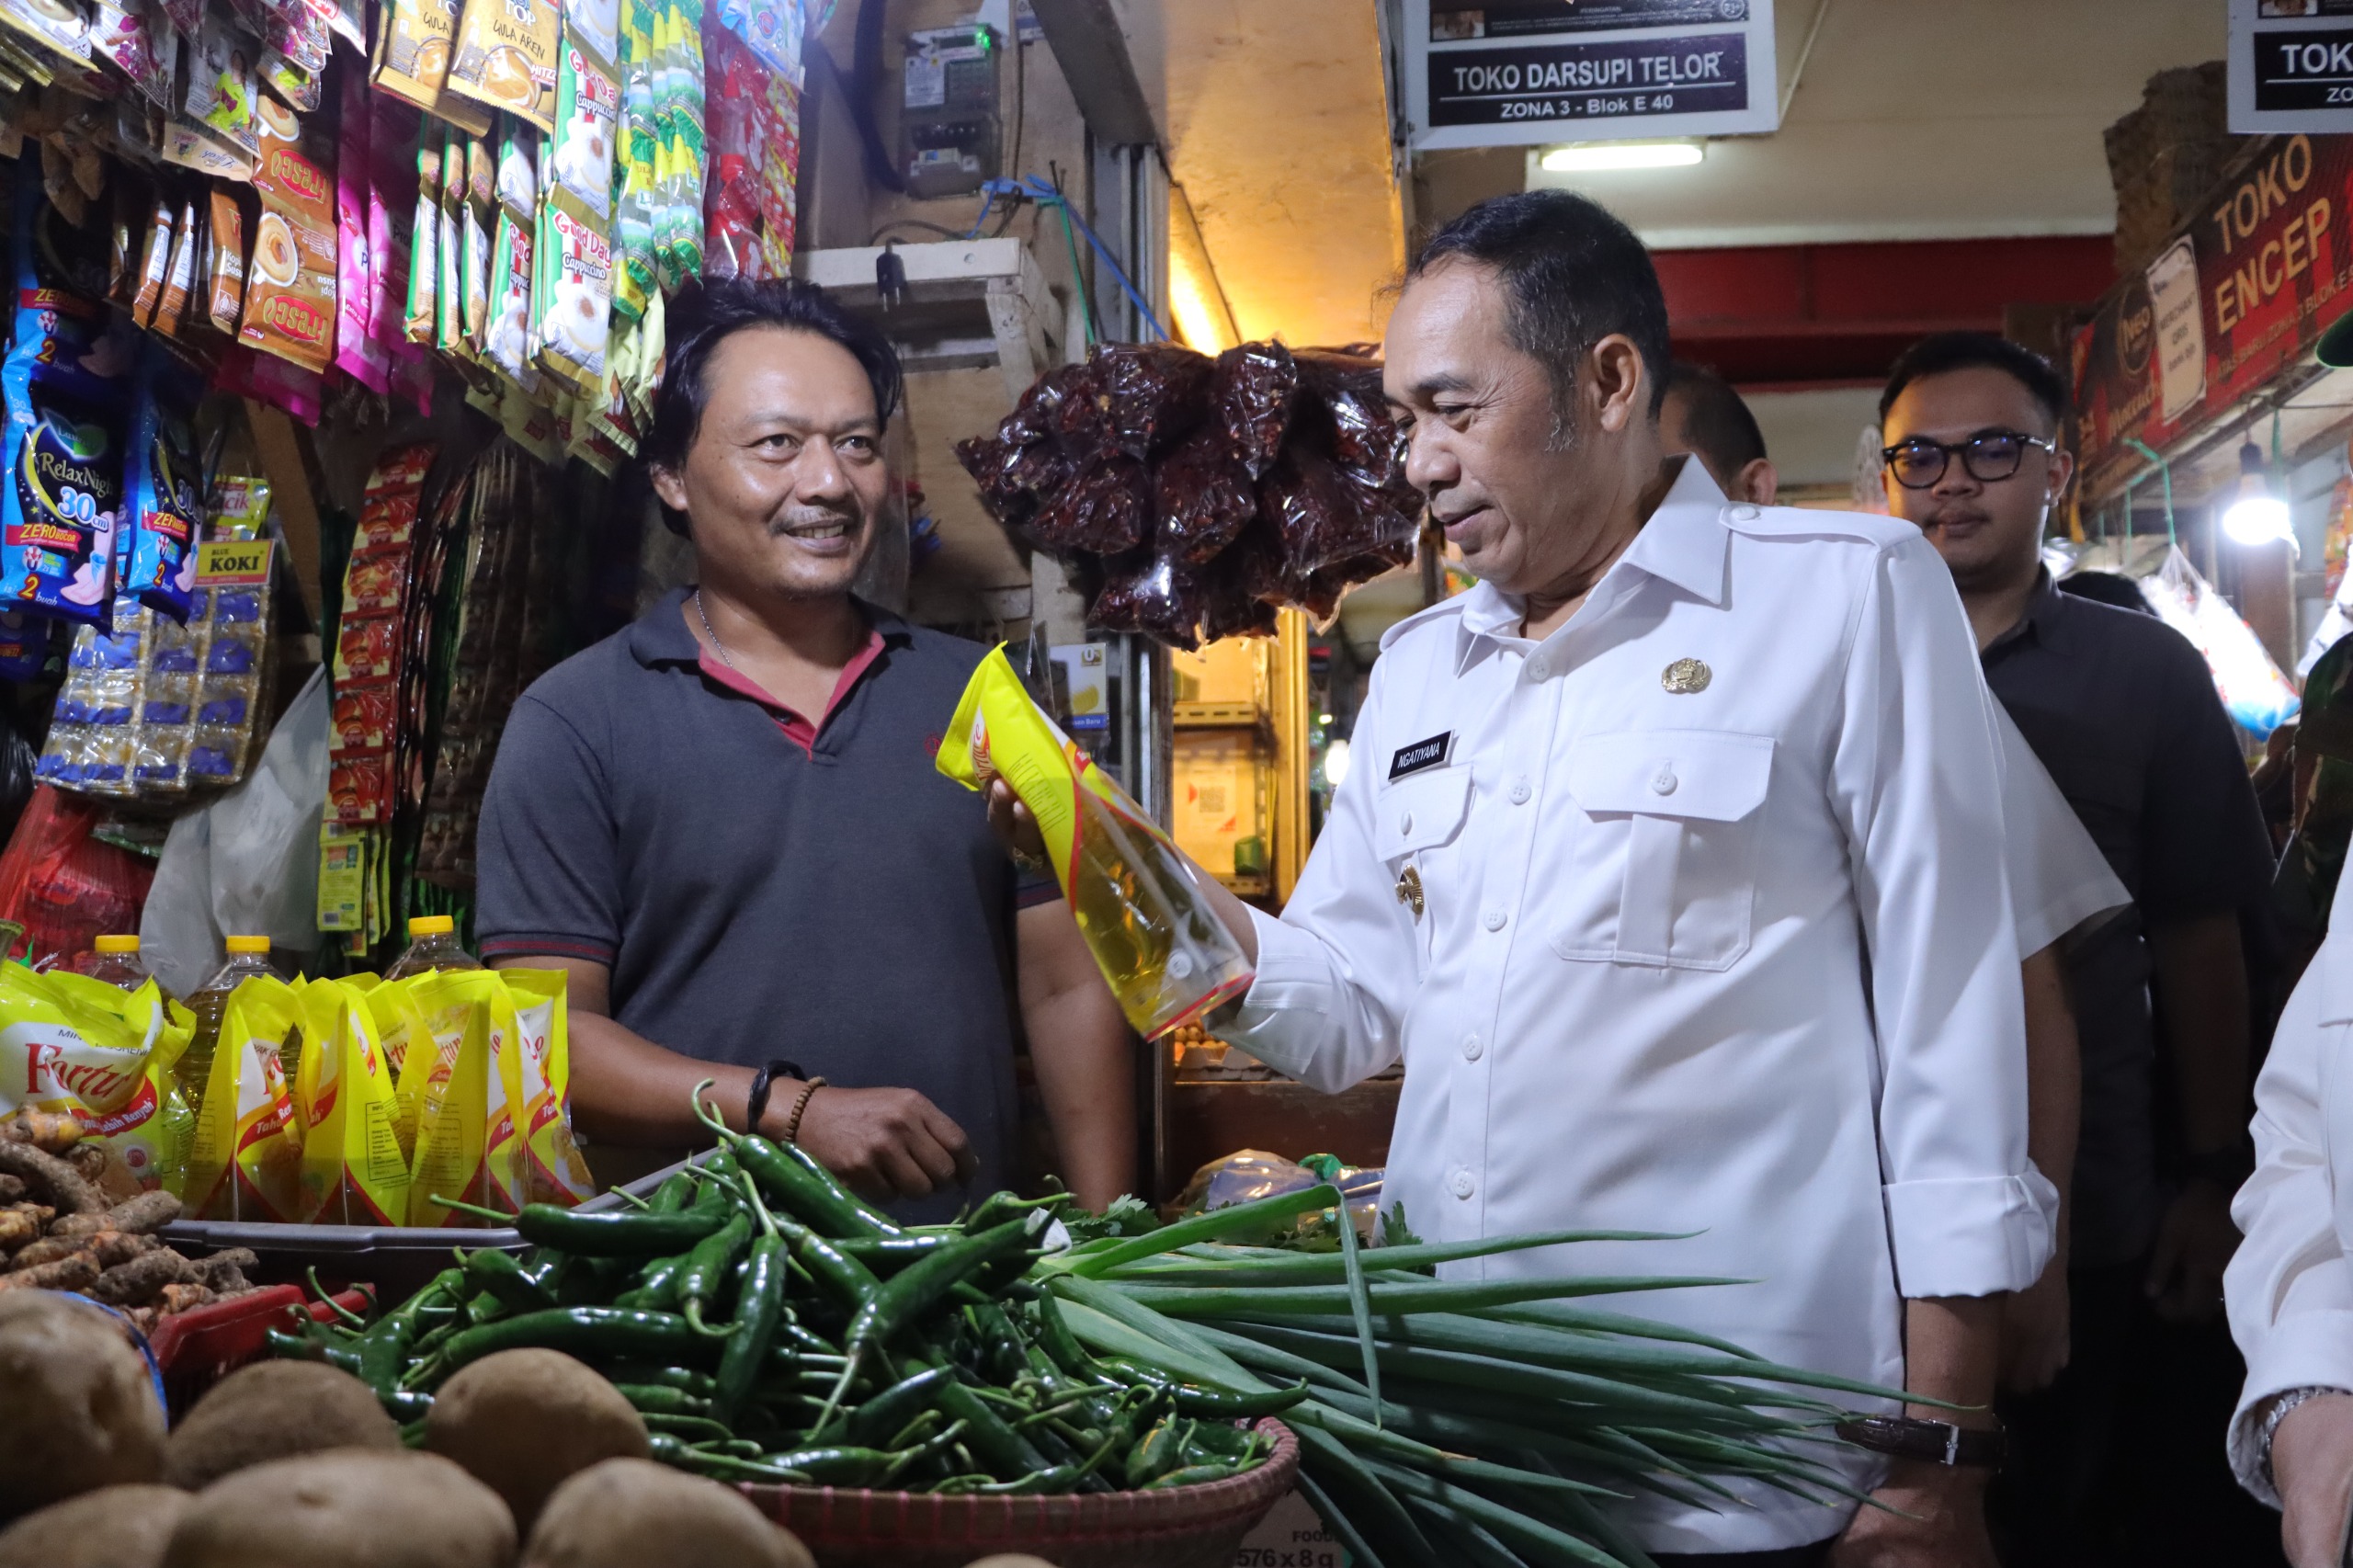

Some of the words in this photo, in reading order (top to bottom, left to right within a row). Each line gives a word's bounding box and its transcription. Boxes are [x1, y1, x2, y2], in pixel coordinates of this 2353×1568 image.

[423, 11, 450, 35] GULA
[494, 19, 517, 42] GULA
[519, 32, 546, 61] AREN
[1453, 64, 1521, 92] TOKO
[1526, 57, 1633, 89] DARSUPI
[1638, 52, 1722, 82] TELOR
[1500, 101, 1553, 119] ZONA
[1560, 101, 1571, 117] 3
[1588, 97, 1628, 115] Blok
[1635, 96, 1646, 111] E
[1653, 94, 1674, 110] 40
[2213, 133, 2313, 255] TOKO
[589, 232, 612, 271] Day
[562, 252, 607, 279] Cappuccino
[2215, 197, 2331, 335] ENCEP
[2304, 280, 2337, 315] BLOK
[38, 340, 55, 362] 2
[39, 451, 114, 499] RelaxNigh
[19, 523, 57, 540] ZERO
[55, 531, 76, 543] BOCOR
[154, 562, 166, 585] 2
[210, 555, 260, 573] KOKI
[18, 574, 40, 598] 2
[35, 591, 58, 607] buah
[1397, 741, 1440, 769] NGATIYANA
[121, 1097, 154, 1124] Renyah
[1236, 1548, 1276, 1568] 576
[1279, 1552, 1291, 1568] x
[1299, 1548, 1313, 1568] 8
